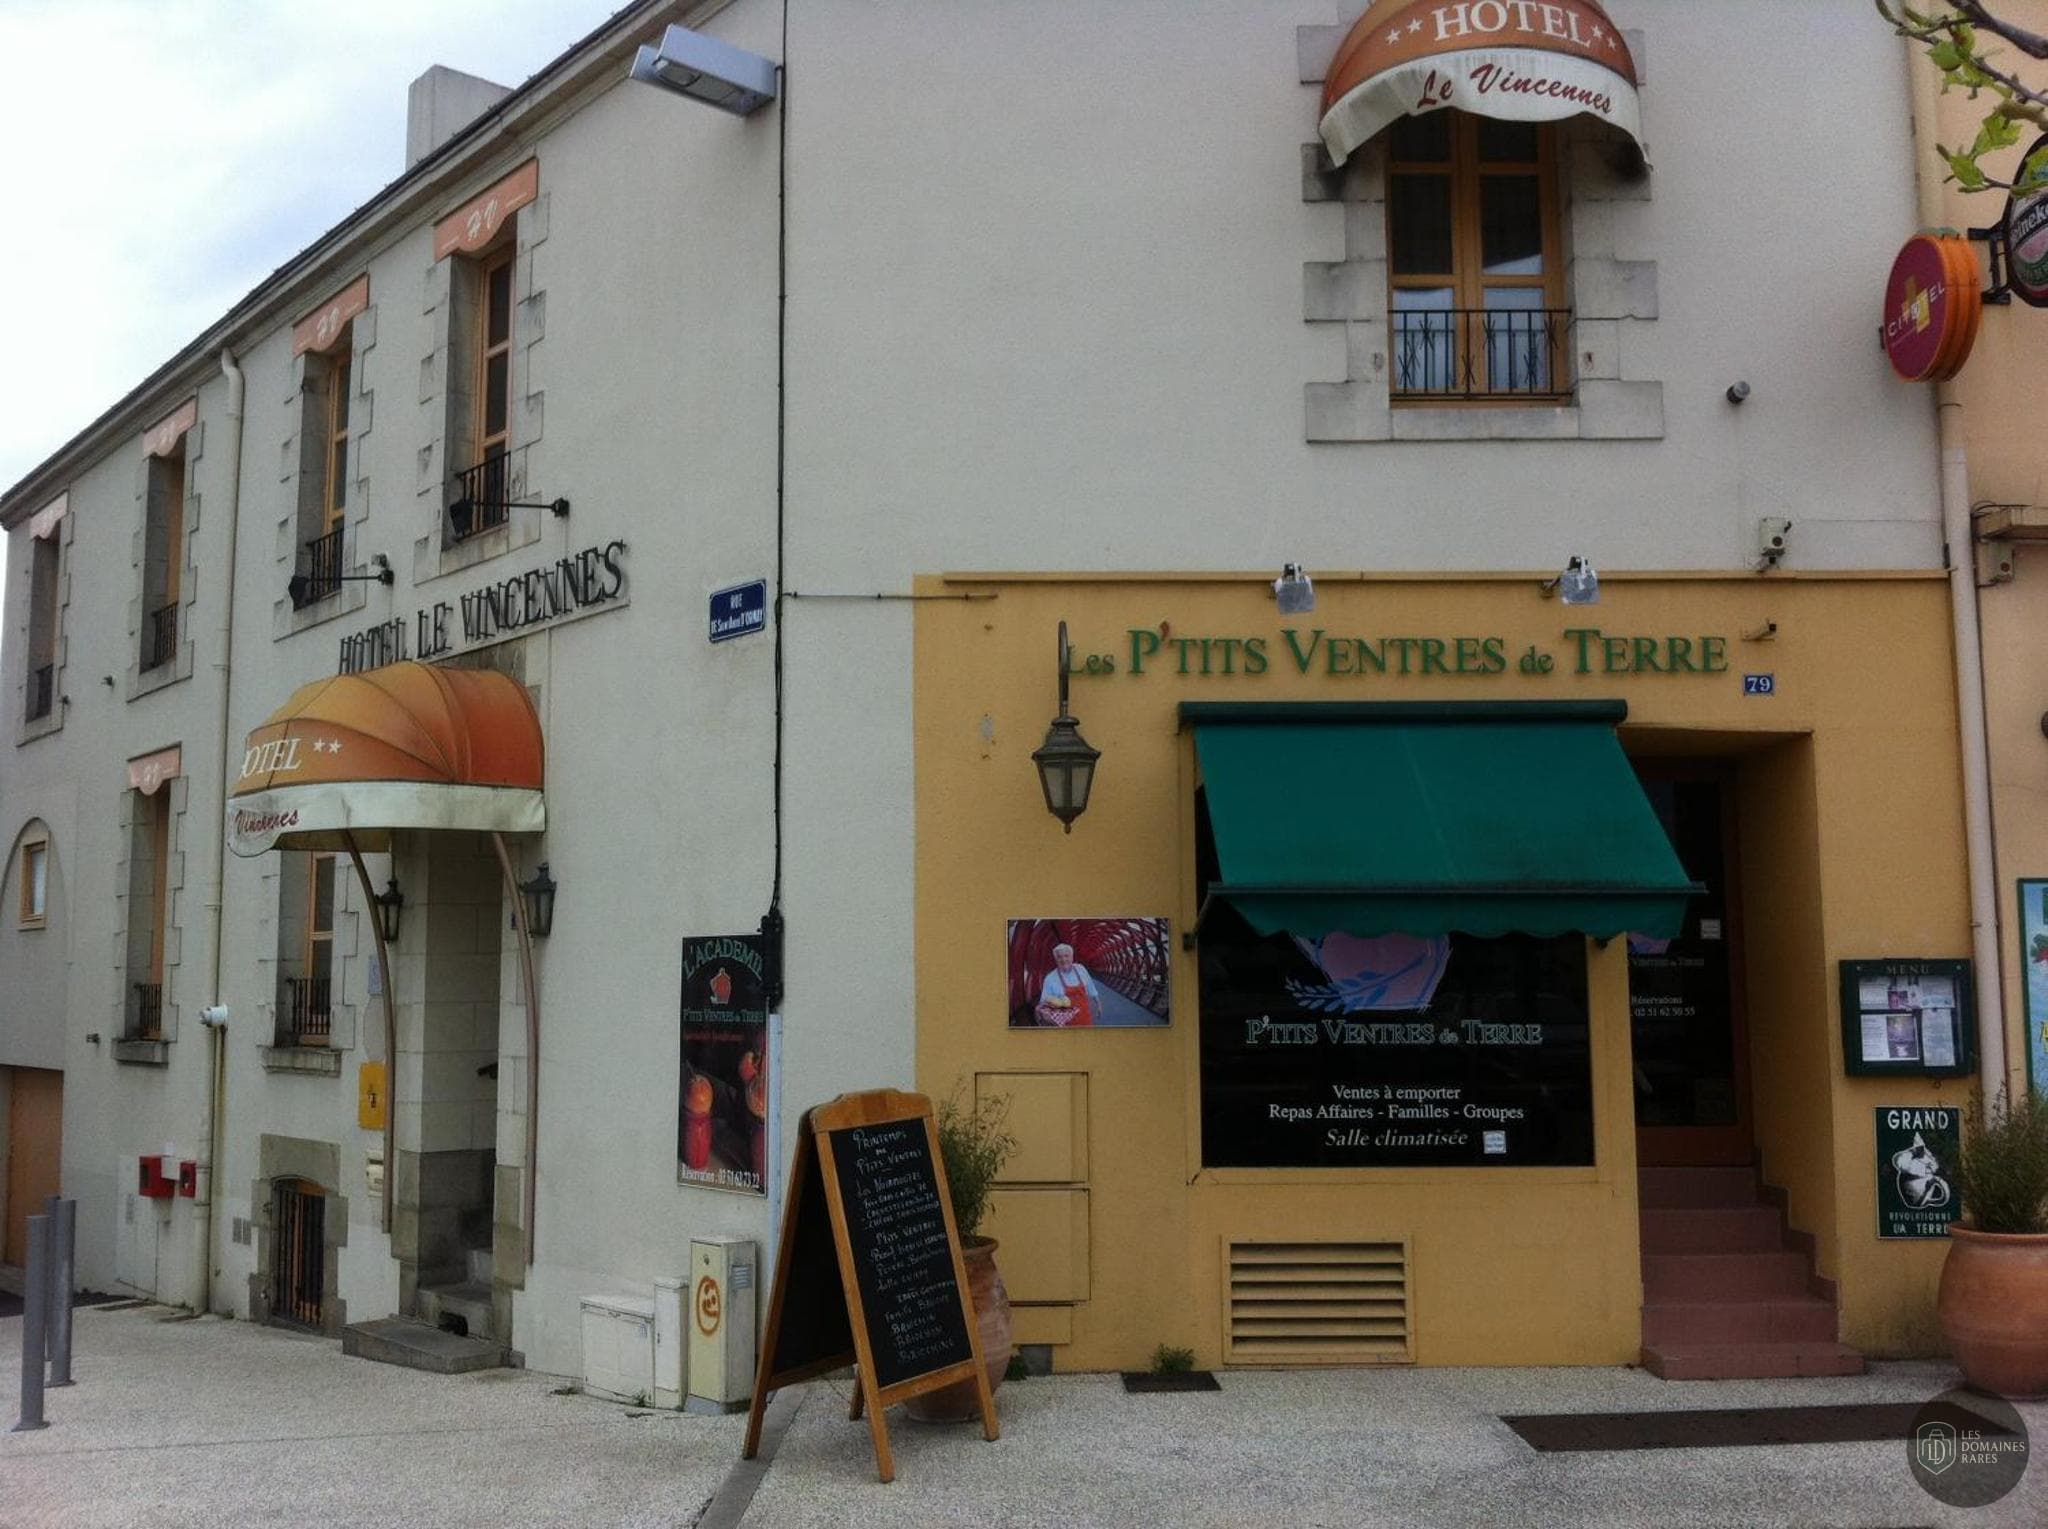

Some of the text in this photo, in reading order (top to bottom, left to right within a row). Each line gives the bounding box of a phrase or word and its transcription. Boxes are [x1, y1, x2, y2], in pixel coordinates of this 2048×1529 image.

[1431, 0, 1592, 48] HOTEL
[1417, 62, 1613, 115] Le Vincennes
[338, 538, 628, 676] HOTEL LE VINCENNES
[1068, 621, 1730, 675] Les P'TITS VENTRES de TERRE
[1747, 677, 1772, 694] 79
[240, 737, 302, 781] OTEL
[1886, 963, 1930, 975] MENU
[1245, 1015, 1544, 1045] P'TITS VENTRES de TERRE
[1332, 1084, 1462, 1103] Ventes à emporter
[1268, 1103, 1313, 1121] Repas
[1316, 1103, 1374, 1119] Affaires
[1388, 1103, 1450, 1119] Familles
[1463, 1103, 1525, 1122] Groupes
[1887, 1109, 1949, 1130] GRAND
[1325, 1128, 1370, 1147] Salle
[1374, 1128, 1469, 1146] climatisée
